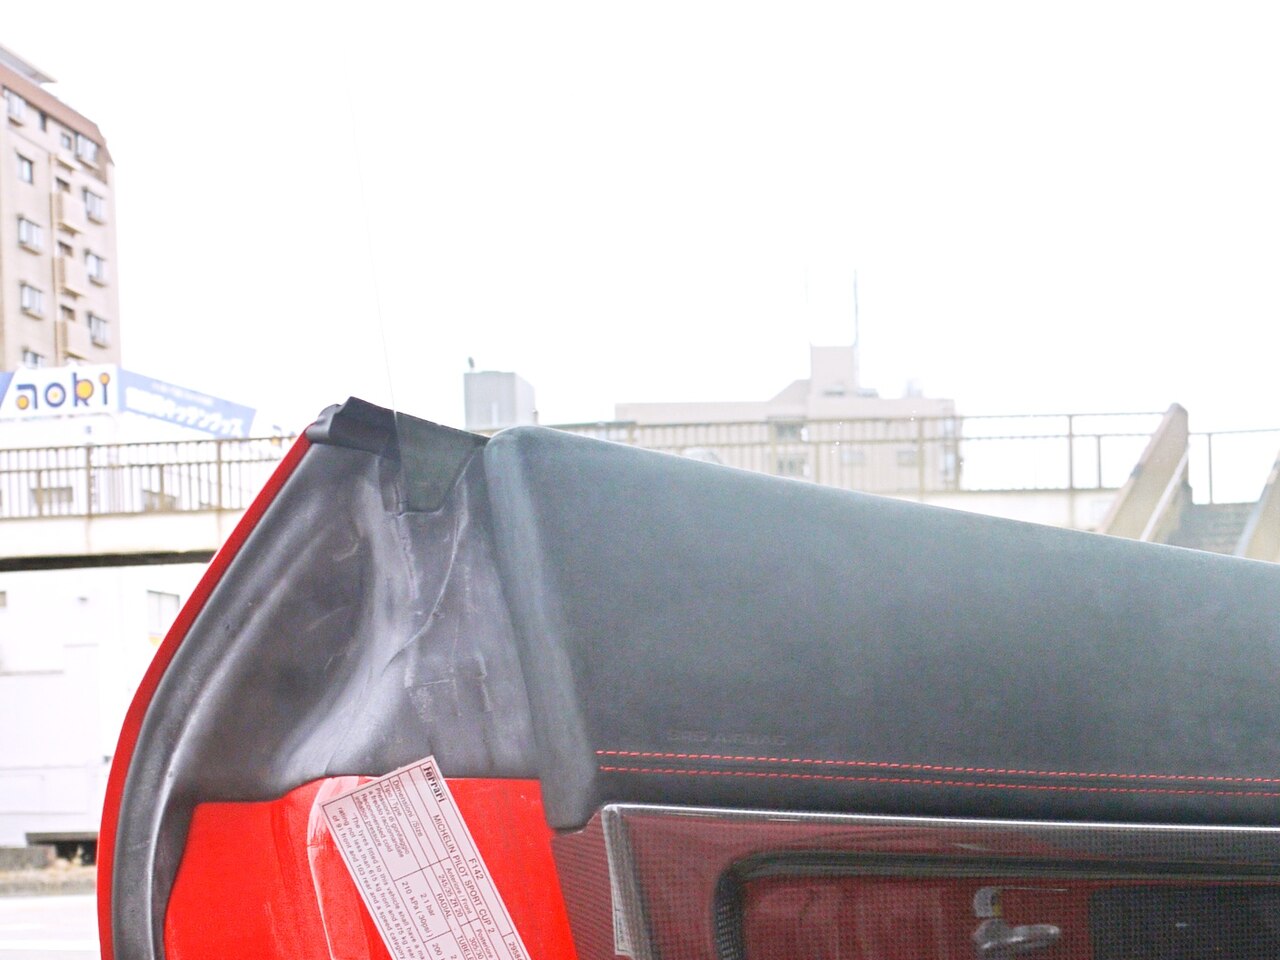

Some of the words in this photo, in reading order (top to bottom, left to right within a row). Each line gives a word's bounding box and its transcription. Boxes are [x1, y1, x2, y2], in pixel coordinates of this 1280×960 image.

[422, 765, 447, 803] Ferrari
[468, 857, 484, 880] F142
[401, 880, 412, 894] 210
[432, 813, 456, 853] MICHELIN
[451, 854, 468, 878] PILOT
[464, 879, 482, 907] SPORT
[478, 907, 491, 926] CUP
[431, 942, 442, 956] 200
